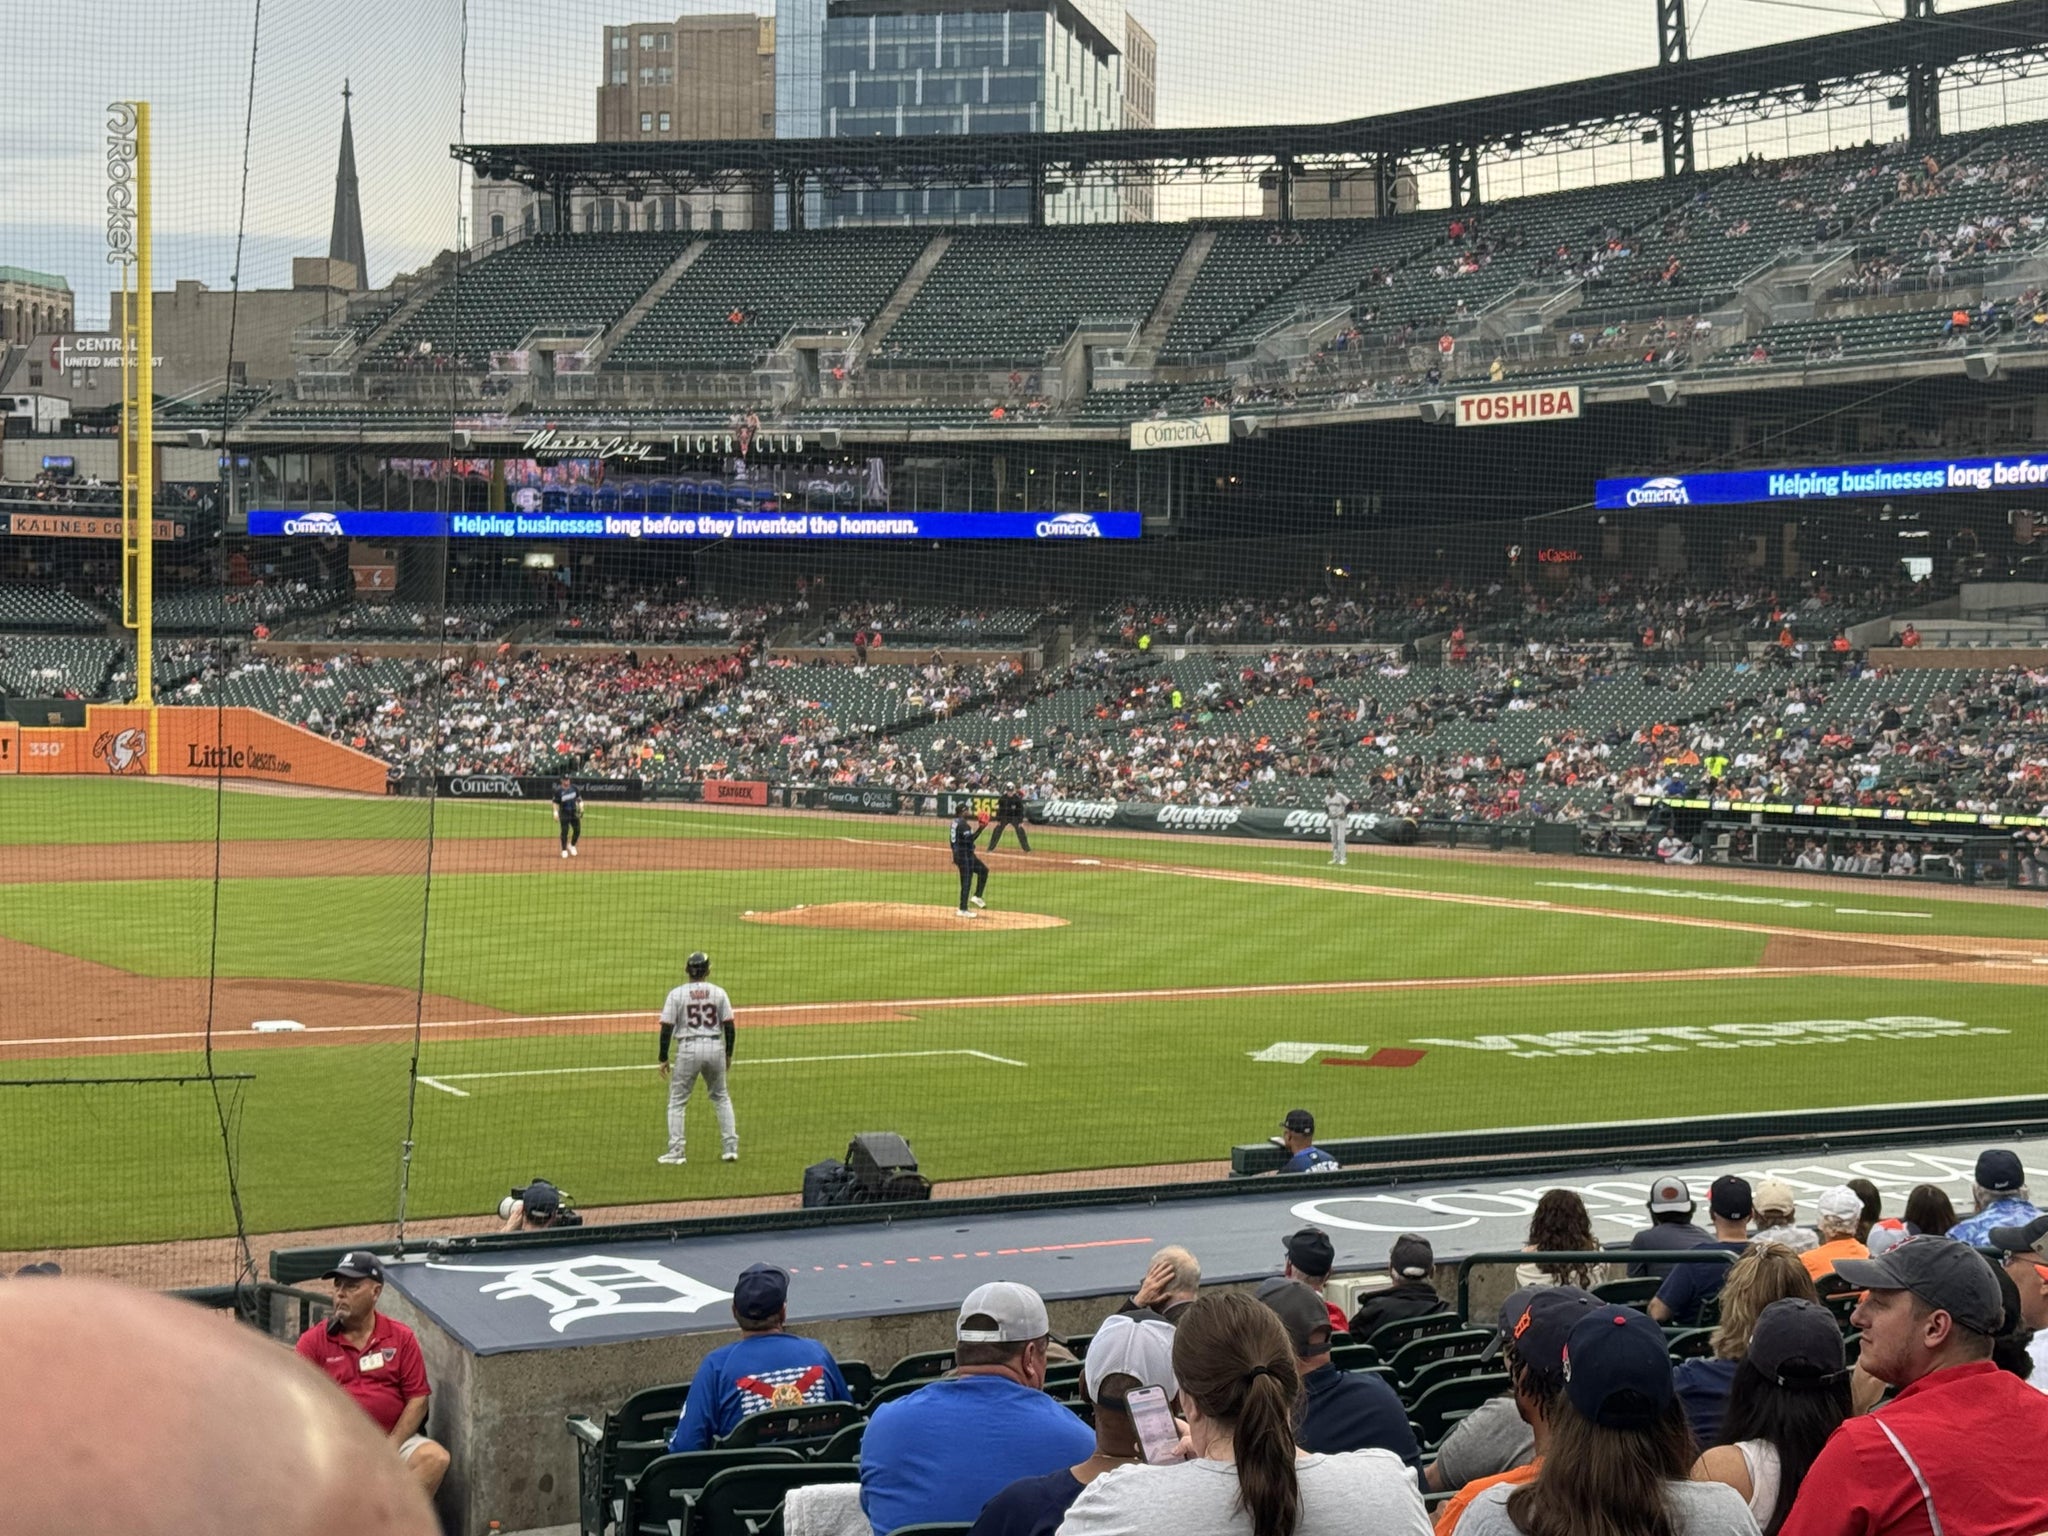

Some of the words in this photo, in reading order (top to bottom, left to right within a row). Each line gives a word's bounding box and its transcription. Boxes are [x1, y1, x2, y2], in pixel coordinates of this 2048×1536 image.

[107, 136, 138, 266] Rocket
[65, 356, 101, 368] UNITED
[1460, 391, 1574, 421] TOSHIBA
[513, 429, 604, 450] Motor
[599, 436, 666, 460] City
[672, 435, 733, 454] TIGER
[756, 434, 804, 454] CLUB
[1769, 471, 1840, 498] Helping
[1842, 468, 1945, 493] businesses
[1948, 464, 1992, 489] long
[16, 518, 96, 533] KALINE'S
[453, 516, 515, 536] Helping
[517, 515, 603, 534] businesses
[606, 516, 641, 537] long
[643, 516, 694, 534] before
[698, 516, 734, 538] they
[737, 516, 807, 534] invented
[809, 516, 838, 534] the
[840, 516, 919, 534] homerun.
[187, 743, 245, 768] Little
[718, 785, 753, 799] SEATGEEK
[1042, 800, 1118, 819] Dunham's
[1156, 804, 1242, 824] Dunham's
[1164, 822, 1228, 831] SPORTS
[687, 1003, 717, 1028] 53
[1407, 1016, 1968, 1050] VICTORS
